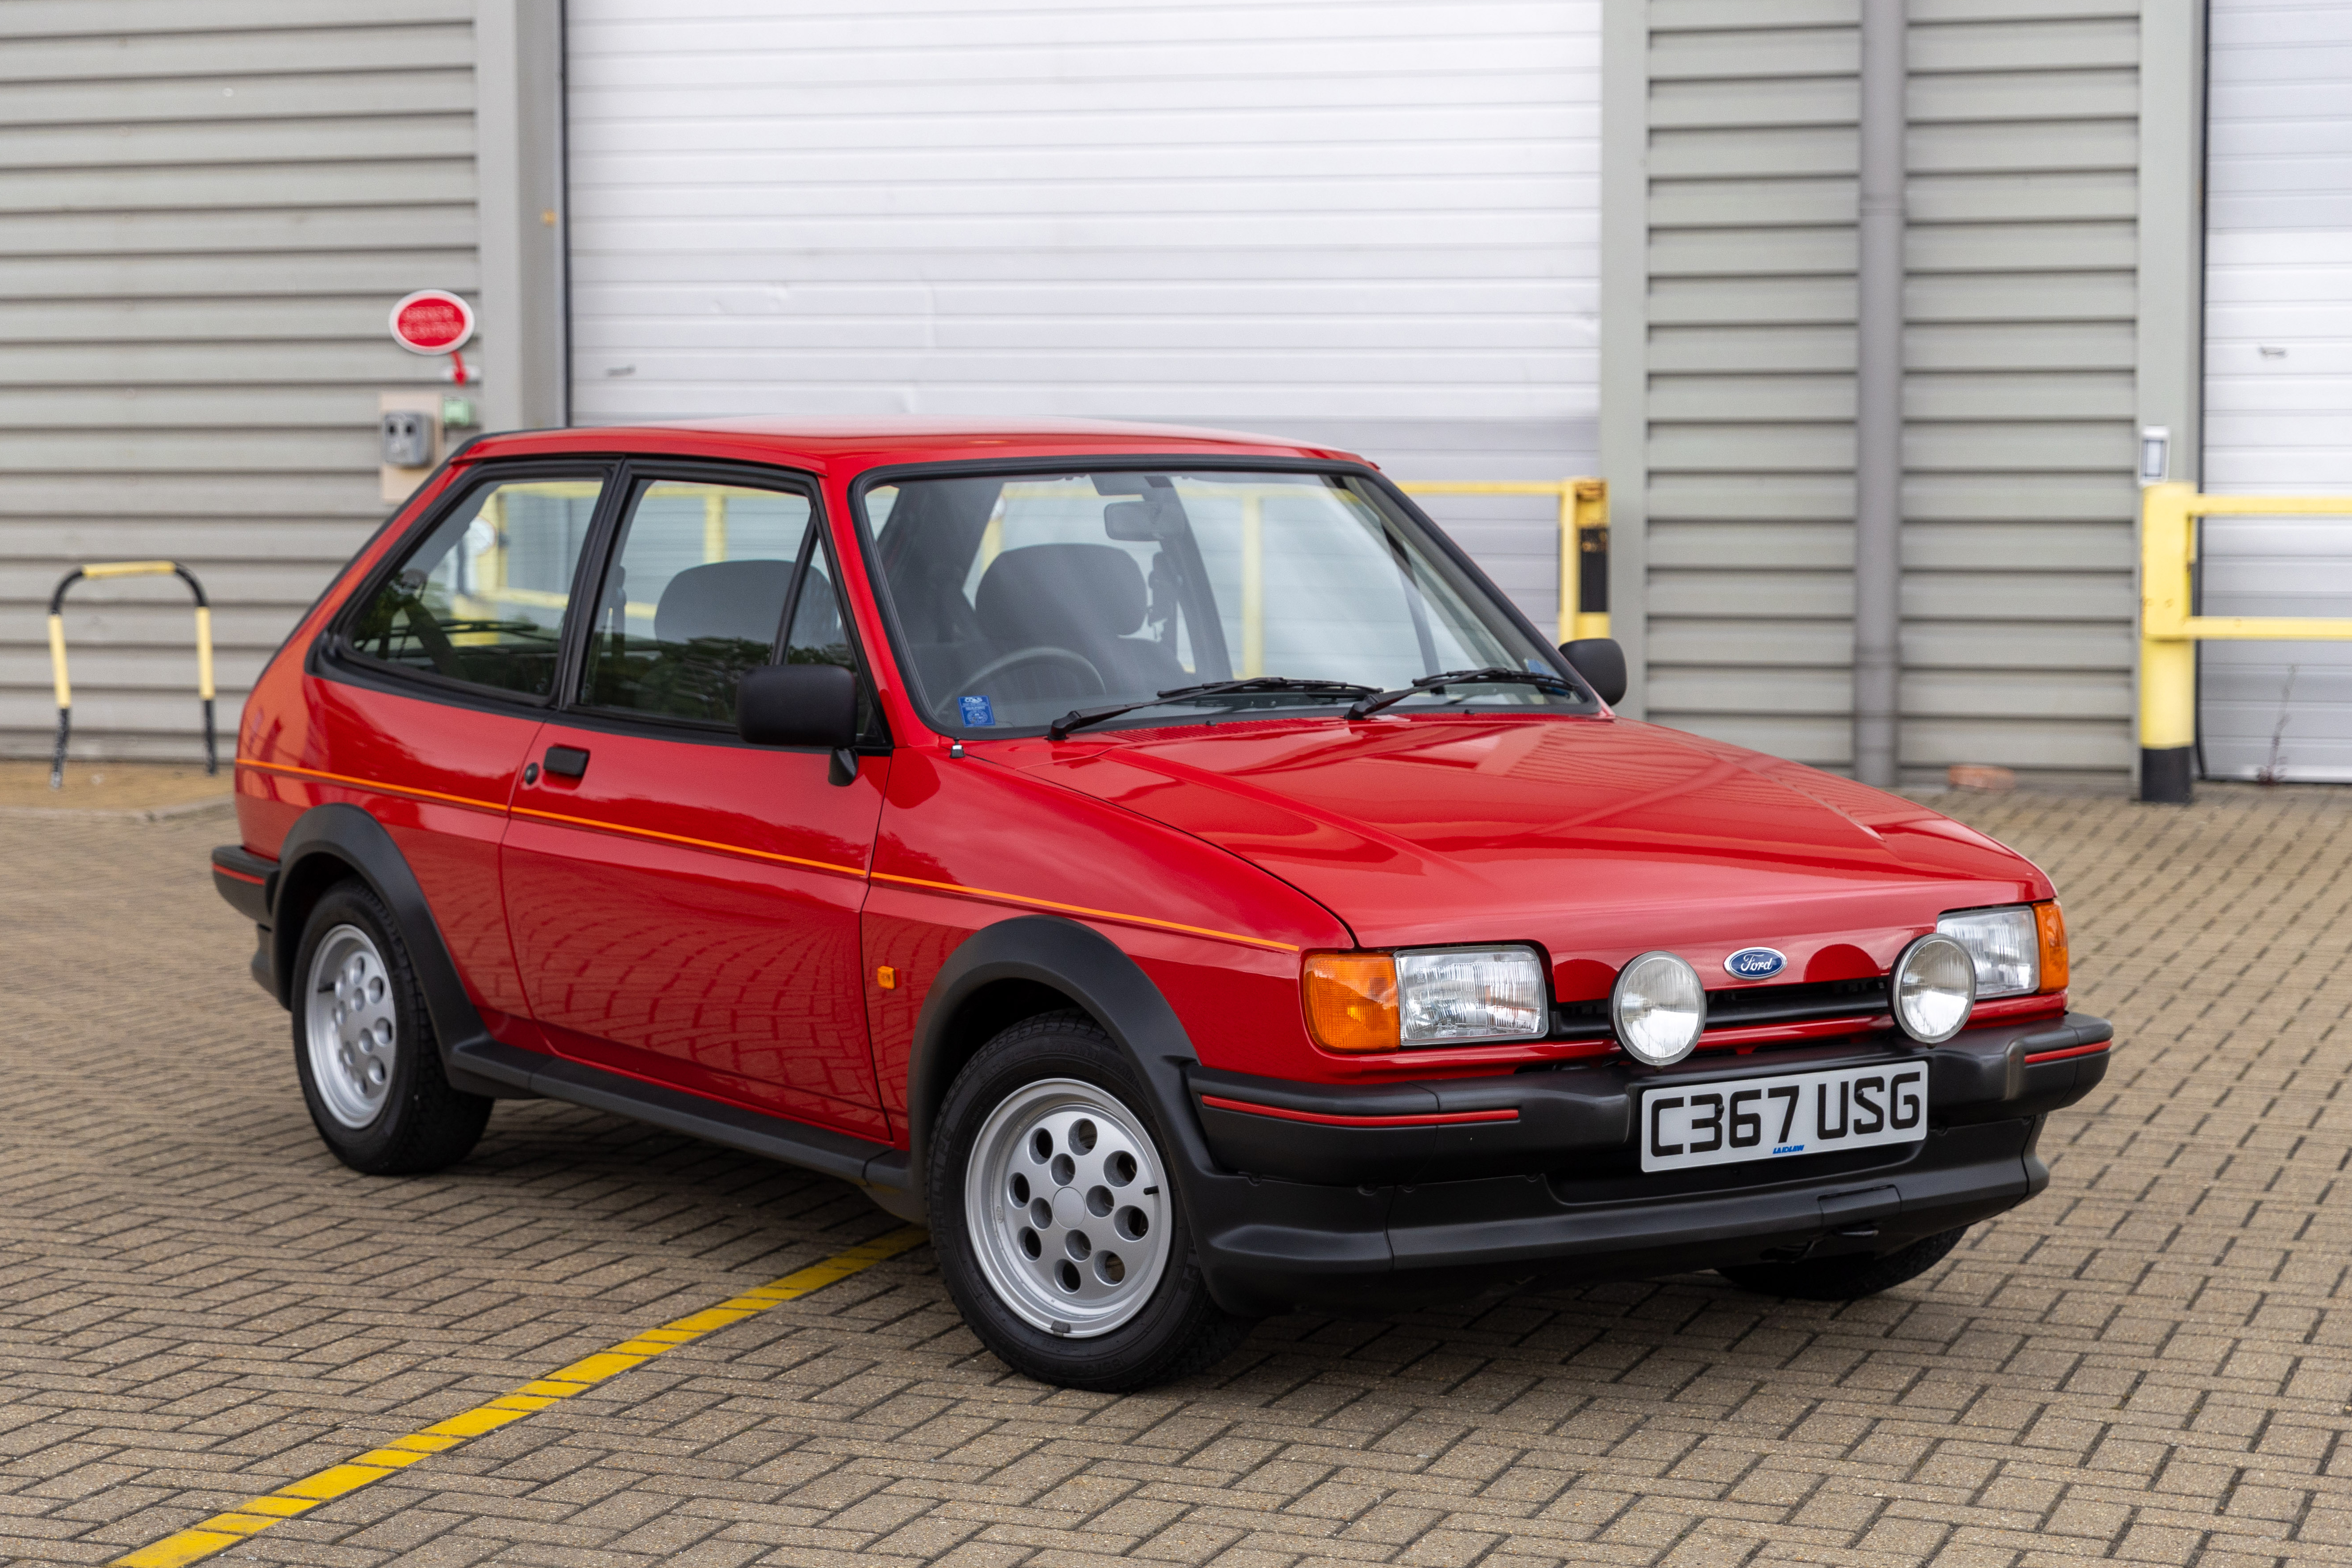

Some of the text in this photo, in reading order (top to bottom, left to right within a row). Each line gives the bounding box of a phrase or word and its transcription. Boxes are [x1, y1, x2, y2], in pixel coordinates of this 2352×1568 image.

[1741, 954, 1772, 971] Ford
[1651, 1072, 1920, 1157] C367 USG
[1773, 1144, 1804, 1155] LAIDLAW
